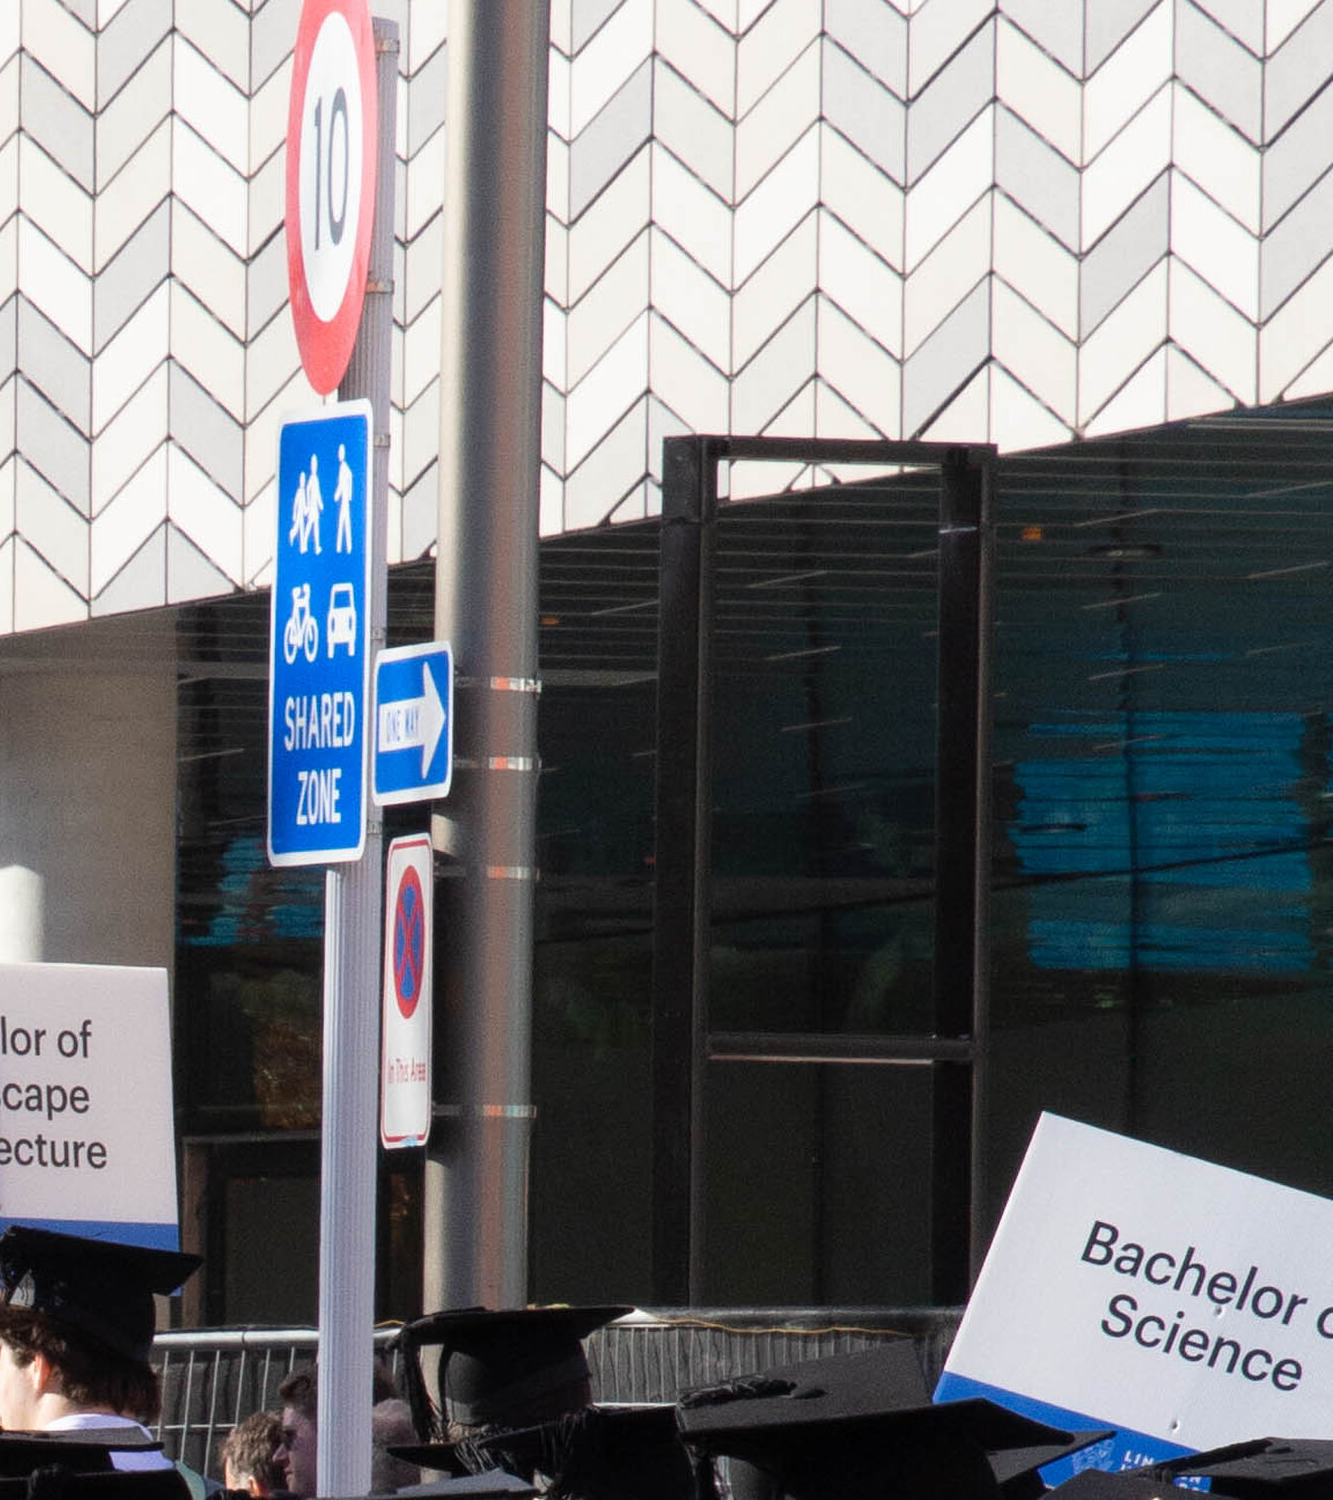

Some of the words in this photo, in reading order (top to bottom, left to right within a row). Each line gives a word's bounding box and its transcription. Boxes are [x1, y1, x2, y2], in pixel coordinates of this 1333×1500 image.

[313, 87, 350, 252] 10
[284, 691, 355, 752] SHARED
[386, 709, 402, 743] ONE
[404, 705, 420, 739] WAY
[296, 768, 342, 826] ZONE
[57, 1019, 92, 1058] of
[1080, 1219, 1309, 1326] Bachelor
[1100, 1294, 1304, 1392] Science
